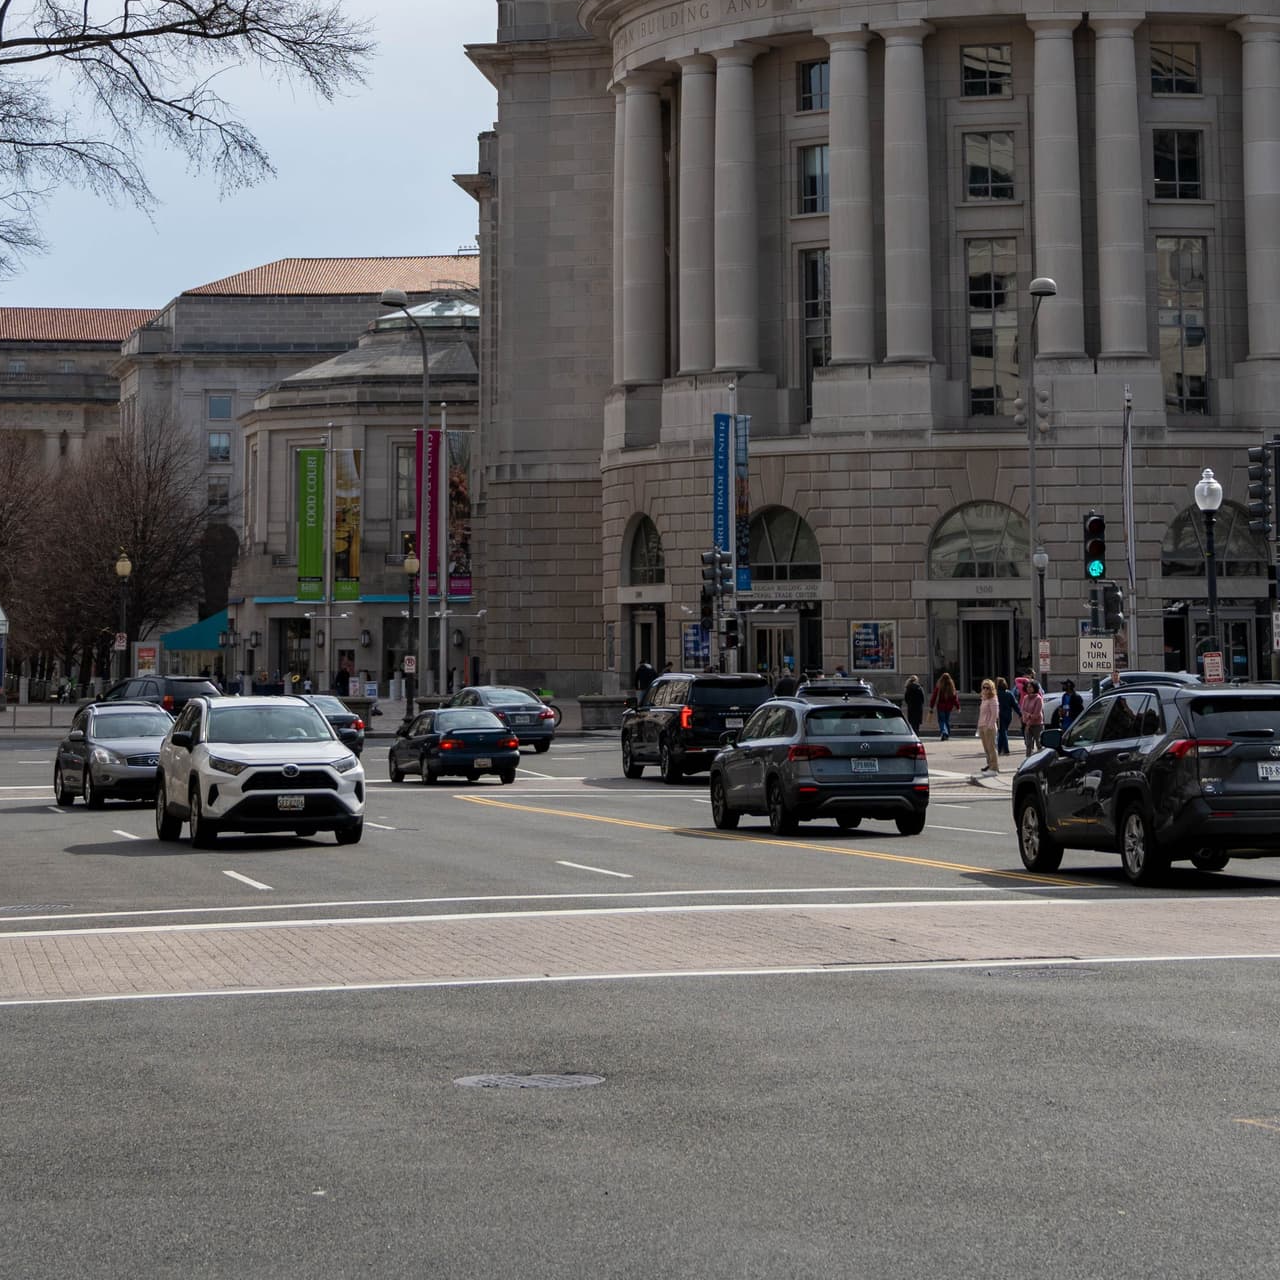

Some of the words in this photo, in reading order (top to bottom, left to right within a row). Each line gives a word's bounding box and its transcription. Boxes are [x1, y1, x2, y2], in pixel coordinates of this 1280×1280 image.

[640, 3, 710, 37] BUILDING
[307, 456, 317, 492] COURT
[306, 496, 317, 527] FOOD
[1090, 641, 1103, 649] NO
[1087, 651, 1107, 659] TURN
[1082, 661, 1093, 669] ON
[1096, 661, 1112, 669] RED
